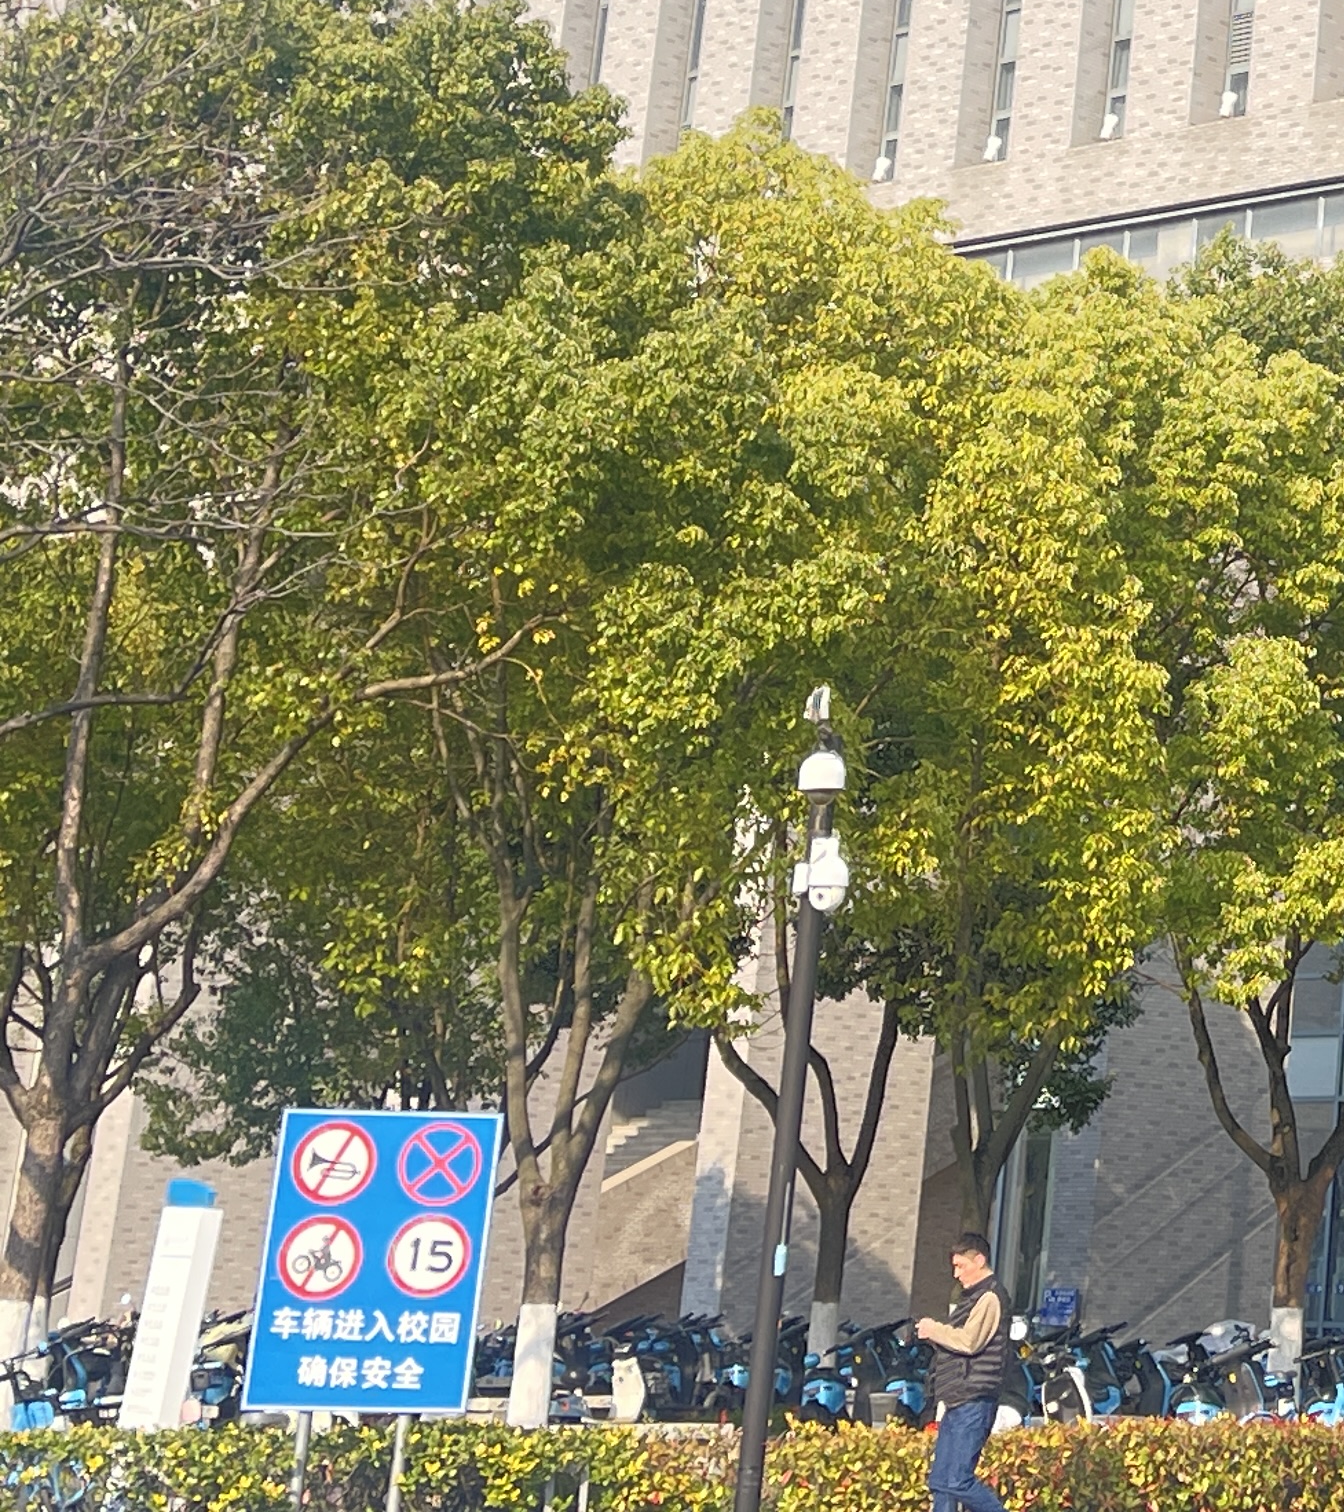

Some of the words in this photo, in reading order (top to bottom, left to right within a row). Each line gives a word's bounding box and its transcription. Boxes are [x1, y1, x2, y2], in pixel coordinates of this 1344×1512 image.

[409, 1237, 454, 1274] 15
[269, 1306, 462, 1345] 车辆进入校园
[296, 1354, 425, 1390] 确保安全
